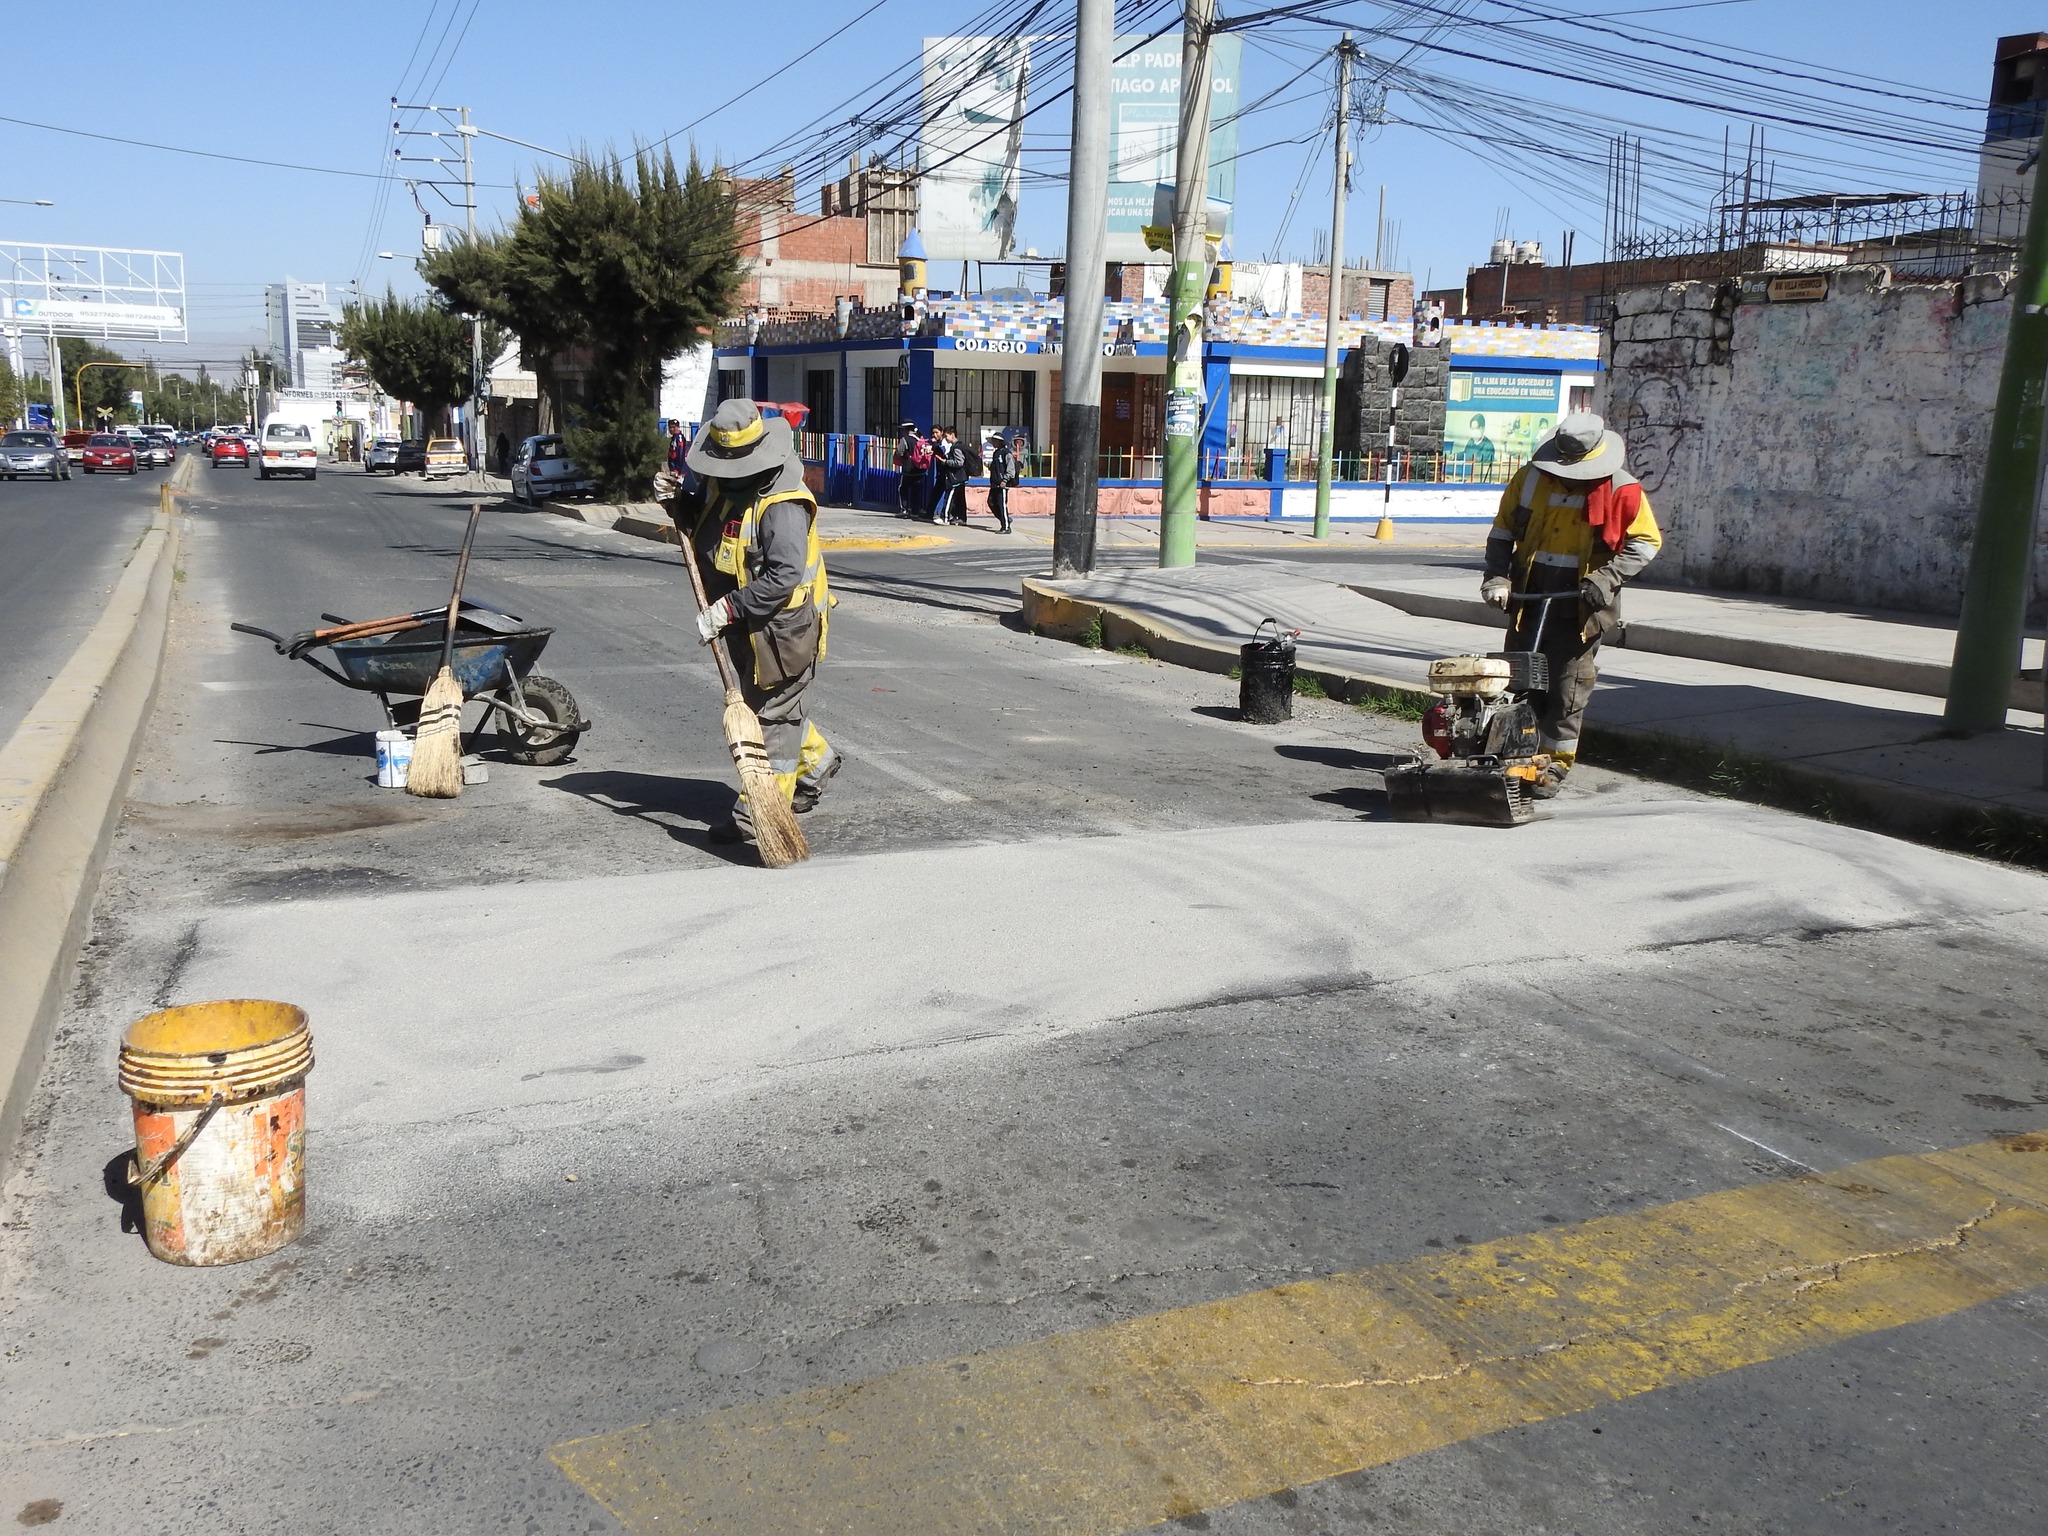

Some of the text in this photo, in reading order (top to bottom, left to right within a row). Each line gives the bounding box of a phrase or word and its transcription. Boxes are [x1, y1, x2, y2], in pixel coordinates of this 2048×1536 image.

[1144, 53, 1183, 68] PADR
[1124, 198, 1134, 206] LA
[1135, 198, 1155, 207] MEJO
[1127, 208, 1143, 217] UNA
[955, 339, 1027, 353] COLEGIO
[1487, 387, 1519, 395] EDUCACIÓN
